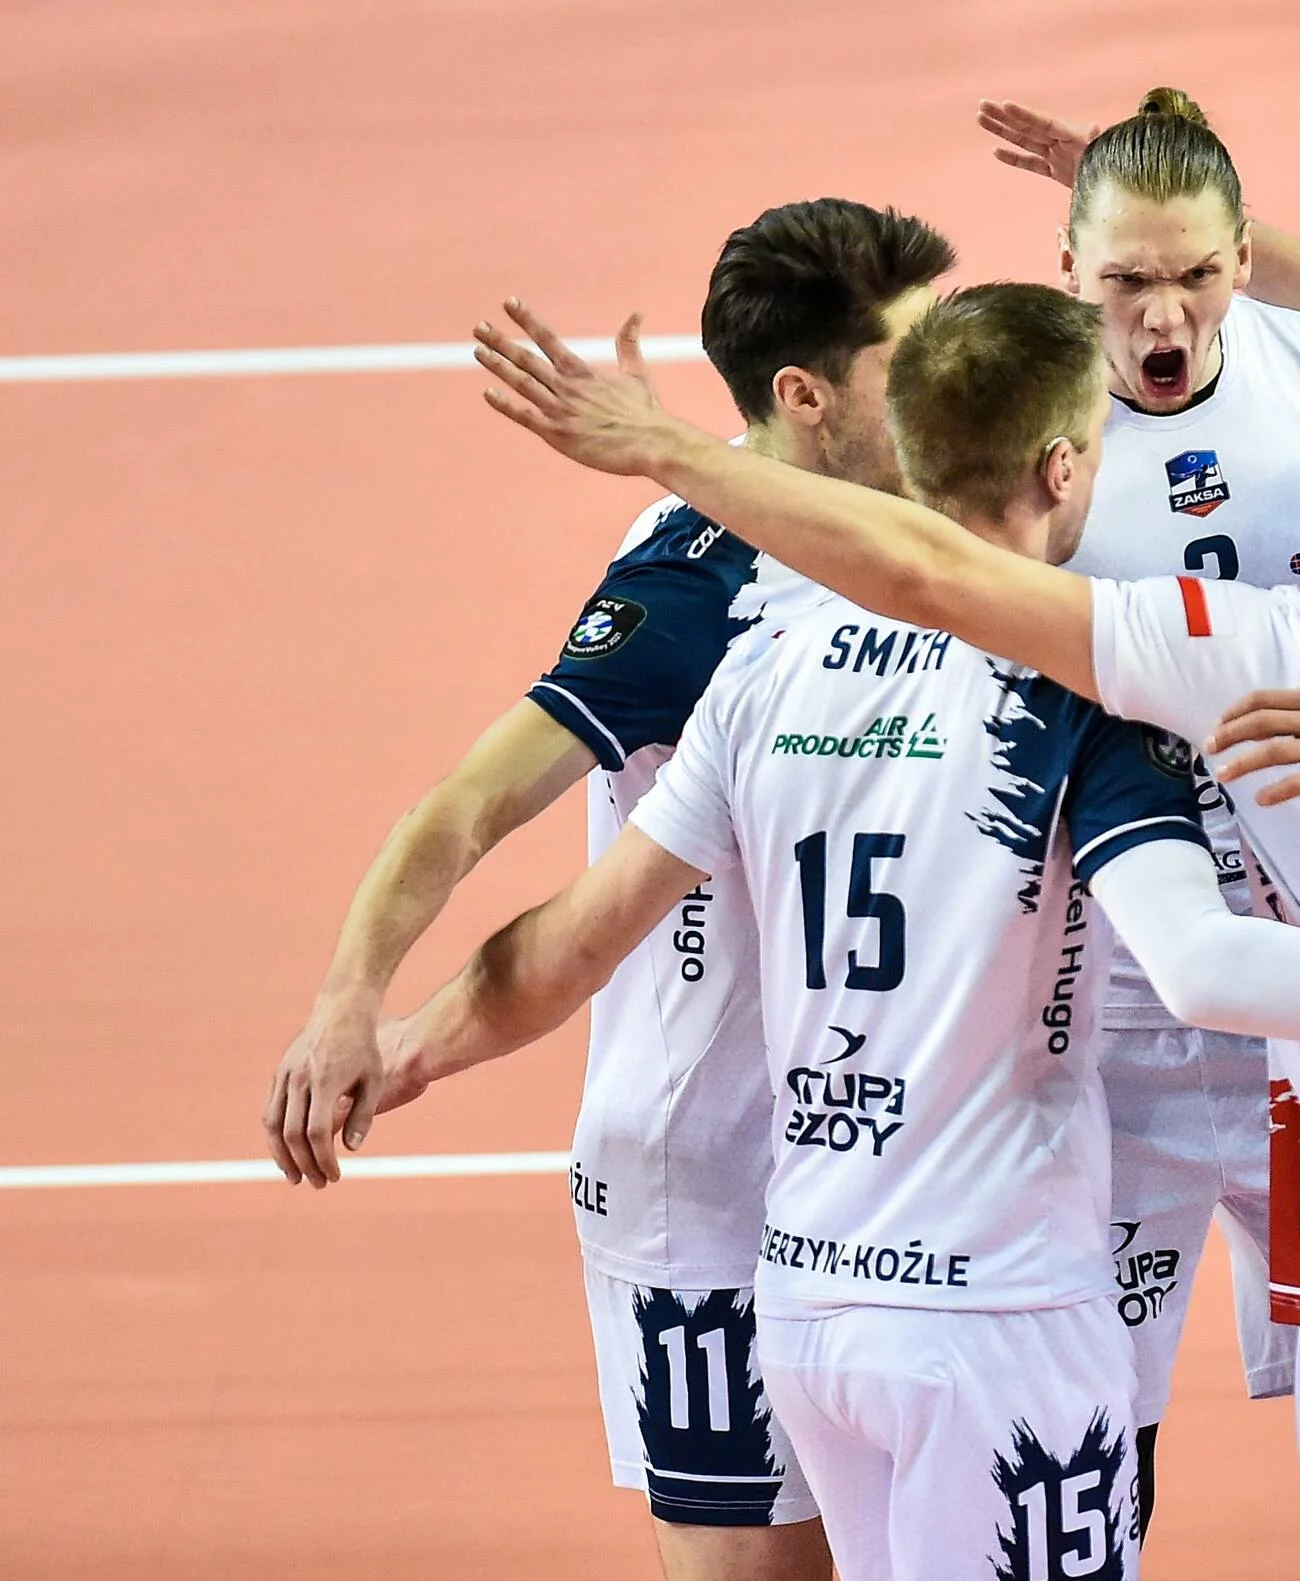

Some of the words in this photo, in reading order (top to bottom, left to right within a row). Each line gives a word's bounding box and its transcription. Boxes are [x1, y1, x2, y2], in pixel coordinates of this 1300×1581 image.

[1174, 487, 1225, 508] ZAKSA
[771, 734, 904, 759] PRODUCTS
[864, 716, 908, 737] AIR
[794, 831, 907, 991] 15
[1042, 943, 1085, 1055] Hugo
[760, 1224, 971, 1287] IERZYN-KOŹLE
[658, 1325, 730, 1432] 11
[1017, 1469, 1107, 1581] 15
